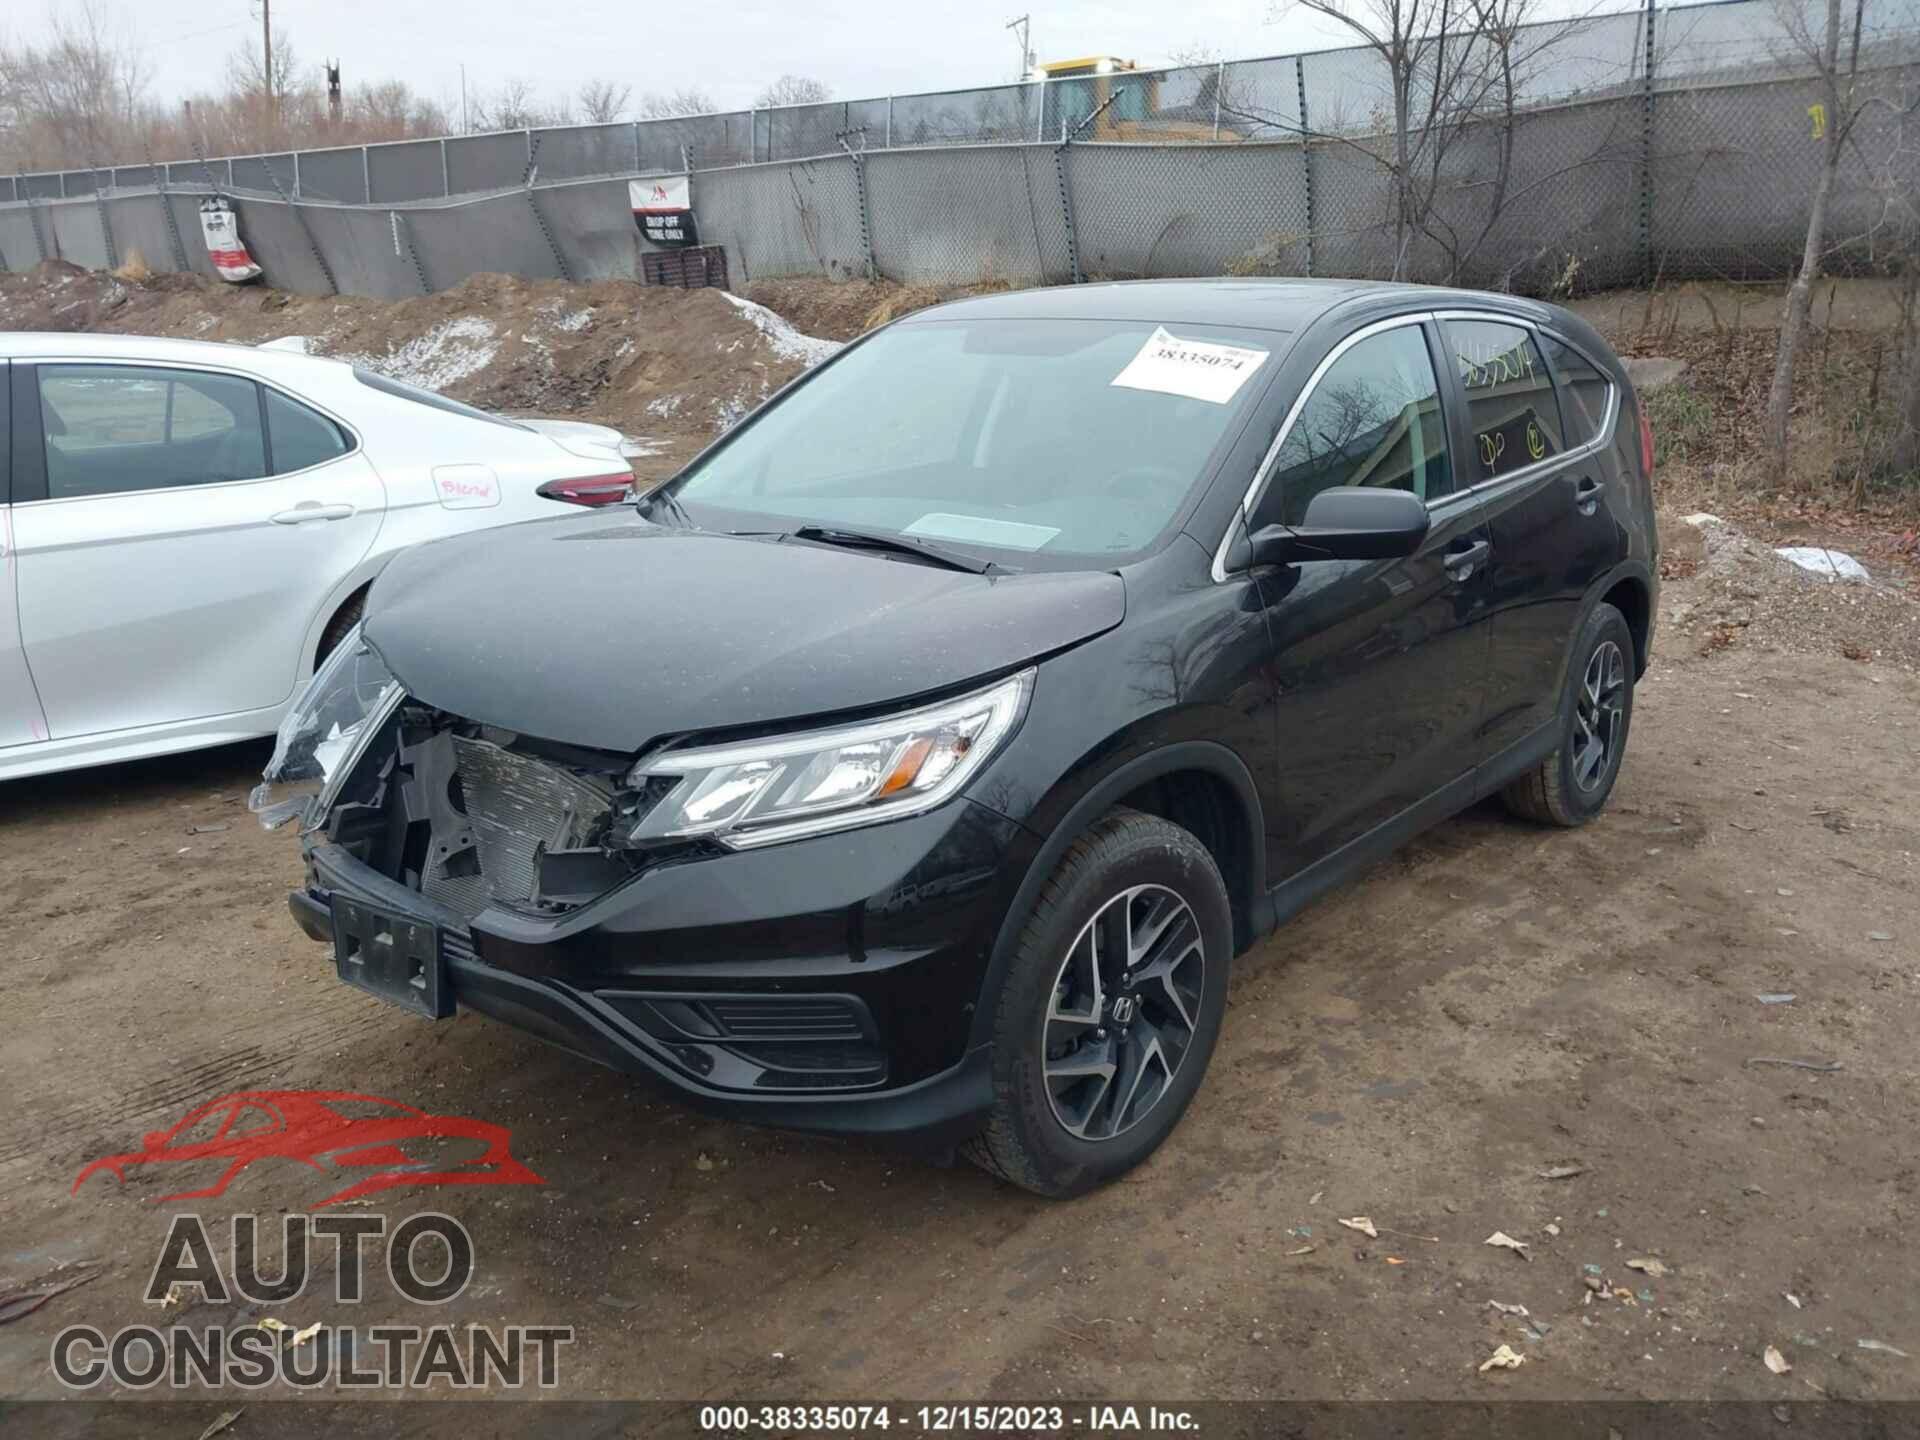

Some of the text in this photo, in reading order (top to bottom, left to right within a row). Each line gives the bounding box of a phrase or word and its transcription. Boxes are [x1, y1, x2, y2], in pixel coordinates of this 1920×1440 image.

[665, 216, 679, 227] OFF
[665, 229, 684, 240] ONLY
[1151, 348, 1245, 371] 38335074
